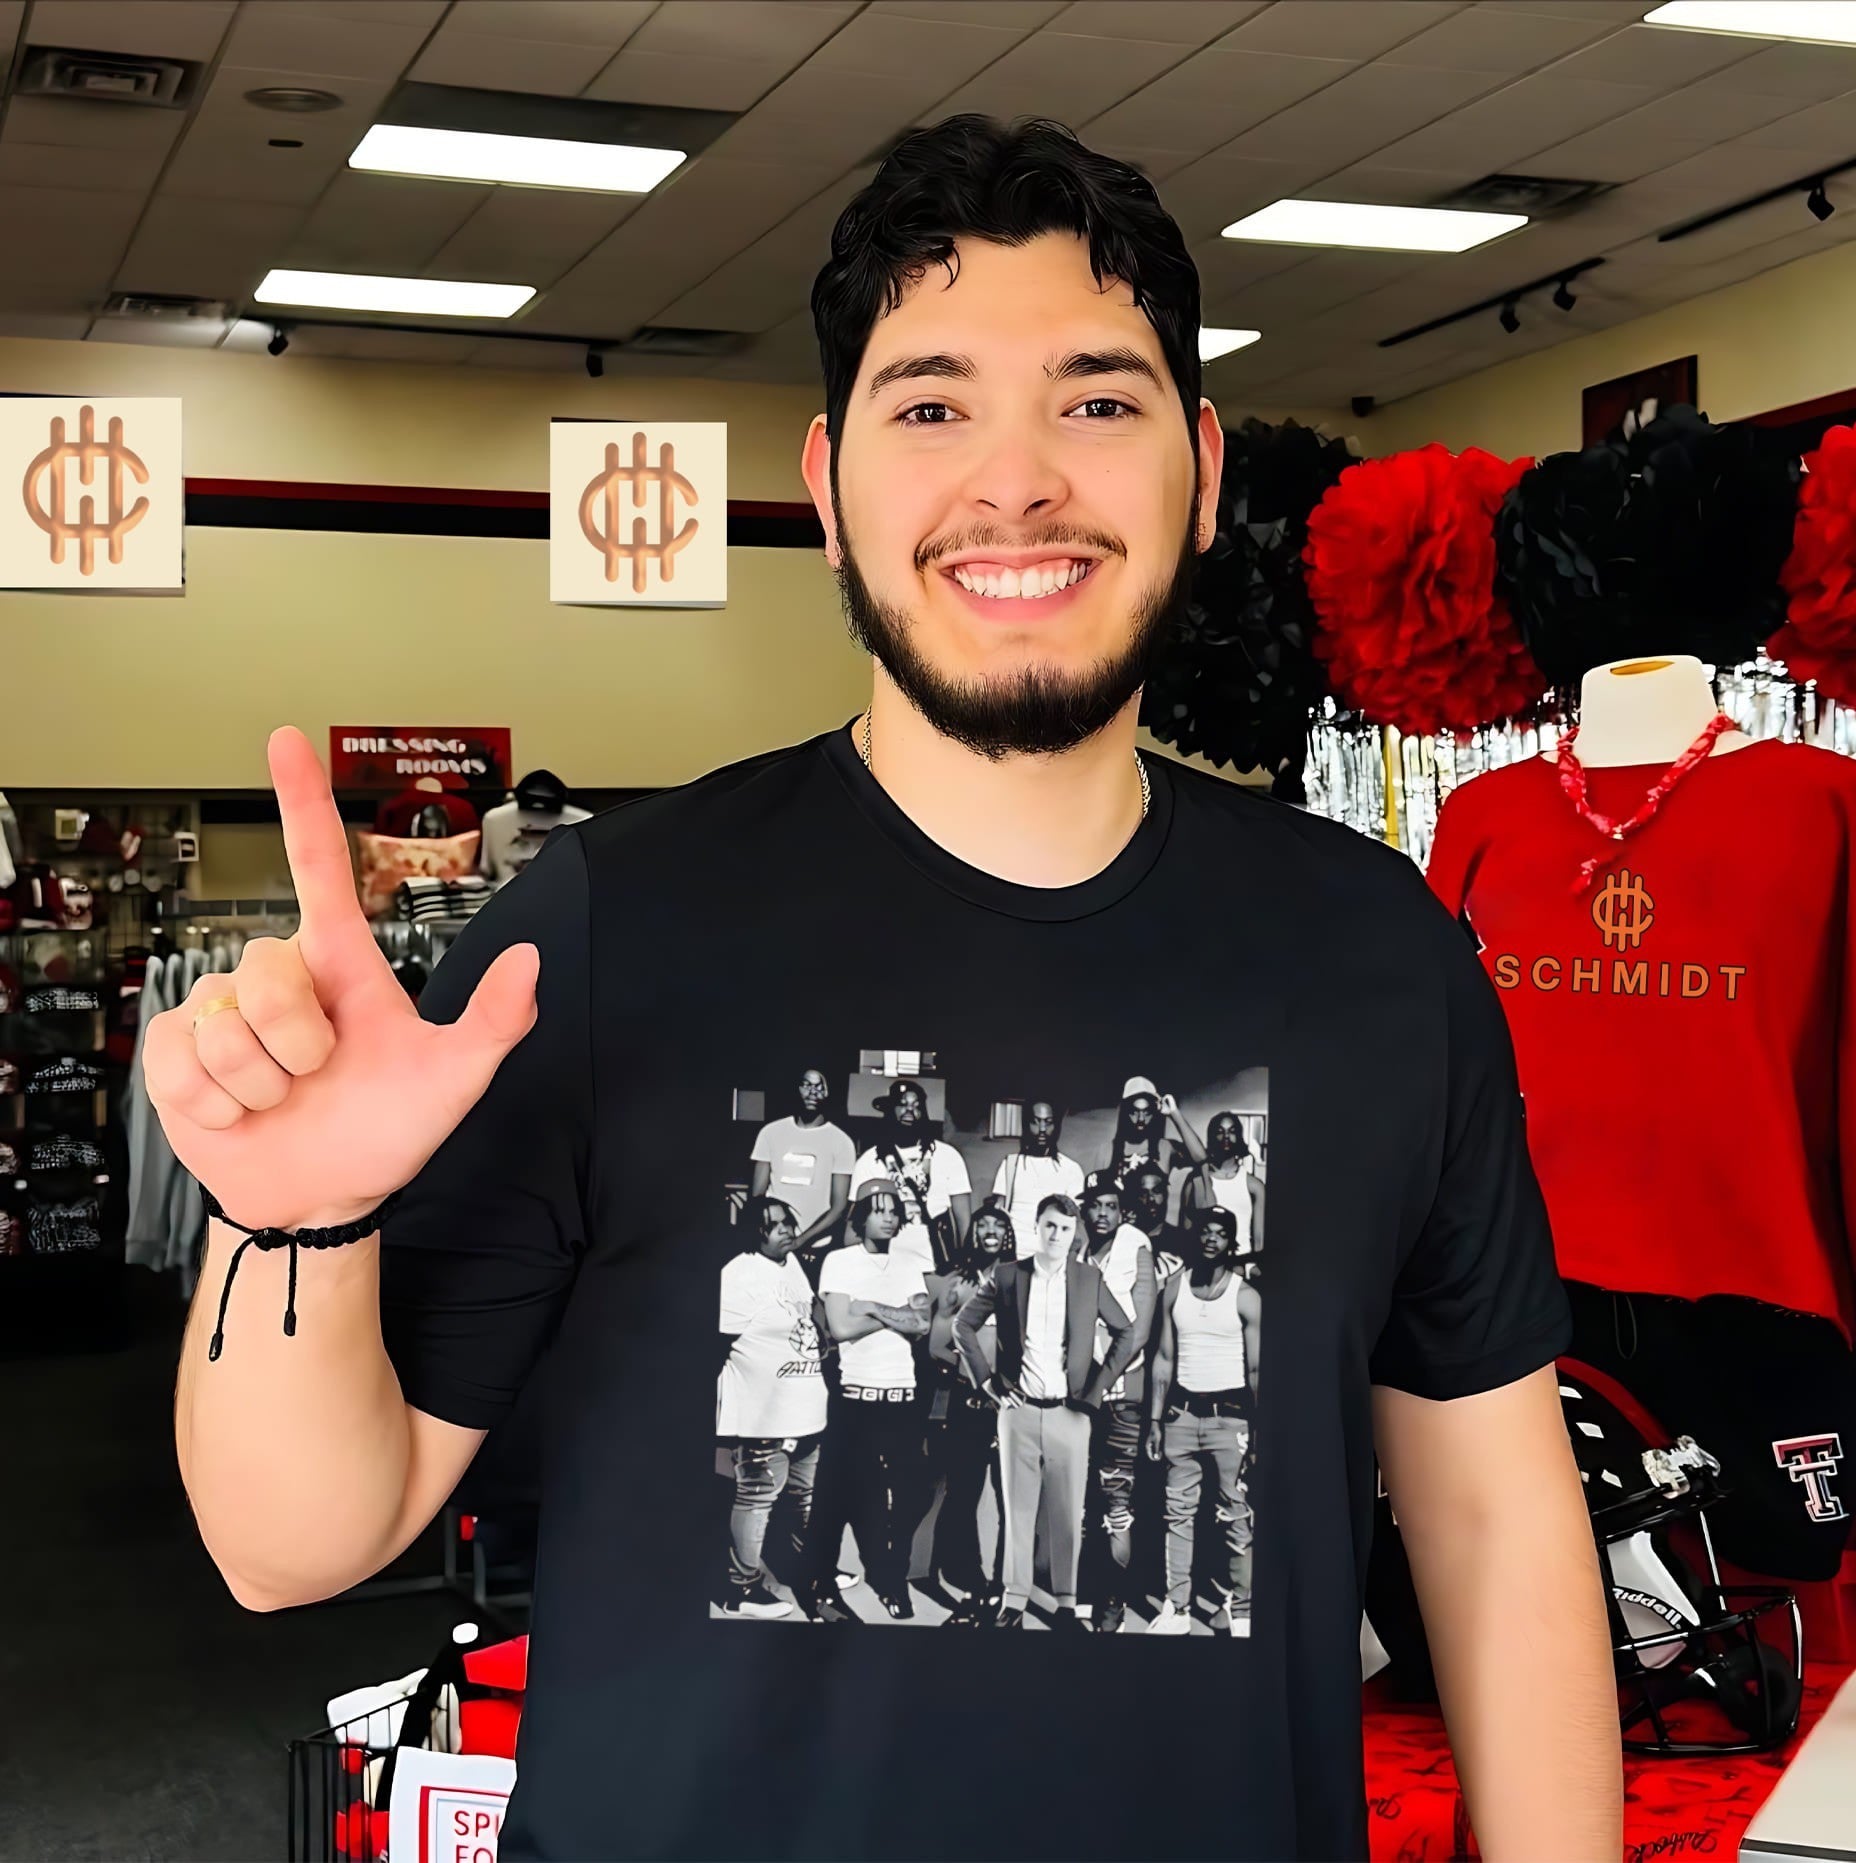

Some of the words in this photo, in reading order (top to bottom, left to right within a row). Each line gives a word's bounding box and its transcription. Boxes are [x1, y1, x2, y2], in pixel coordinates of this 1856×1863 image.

[342, 737, 467, 753] DRESSING
[396, 758, 487, 775] ROOMS
[1494, 954, 1747, 1001] SCHMIDT
